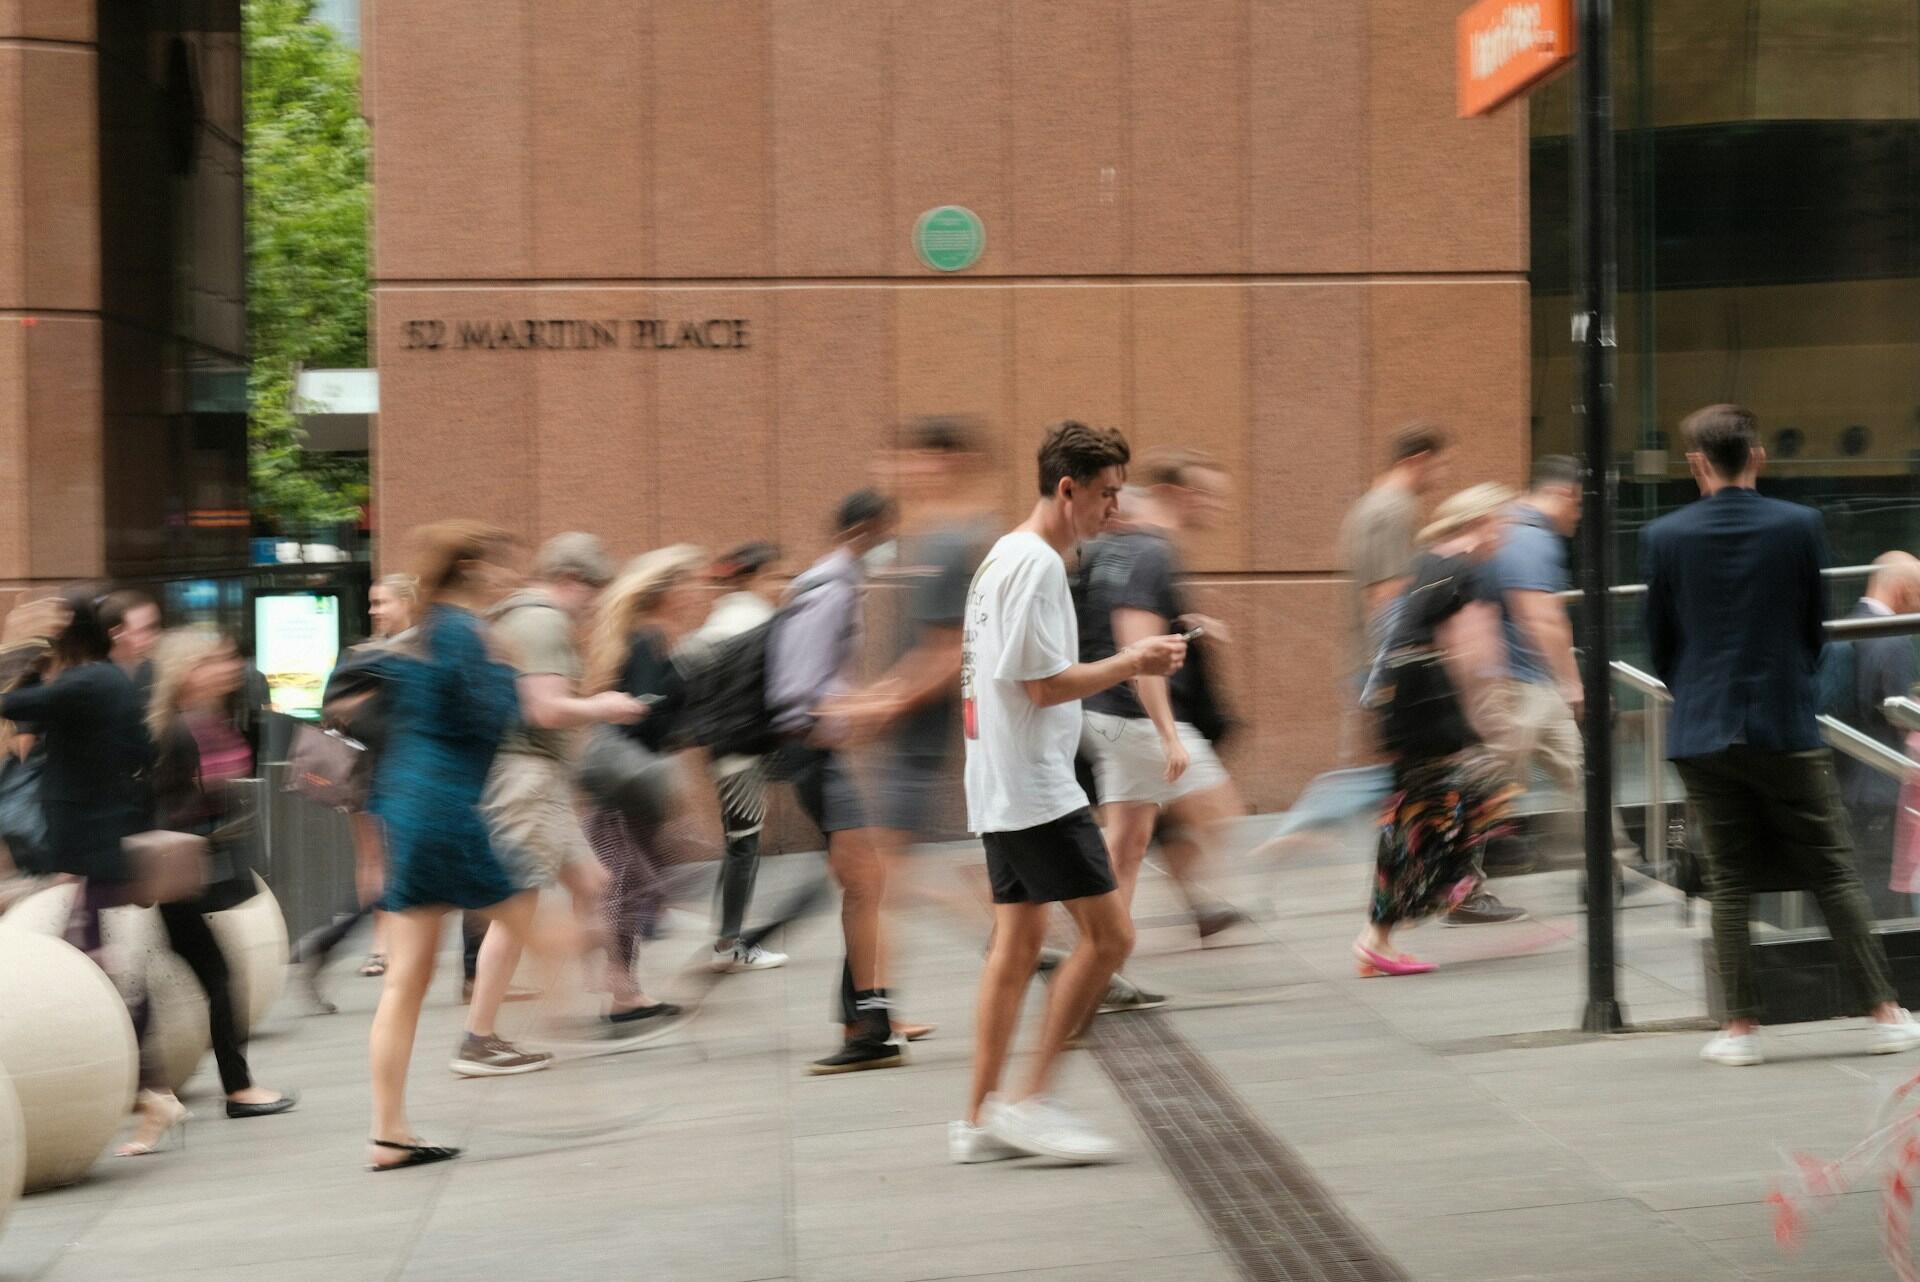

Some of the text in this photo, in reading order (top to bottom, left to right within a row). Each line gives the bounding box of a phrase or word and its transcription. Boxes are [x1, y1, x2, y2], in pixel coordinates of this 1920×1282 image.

[401, 319, 750, 350] 52 MARTIN PLACE
